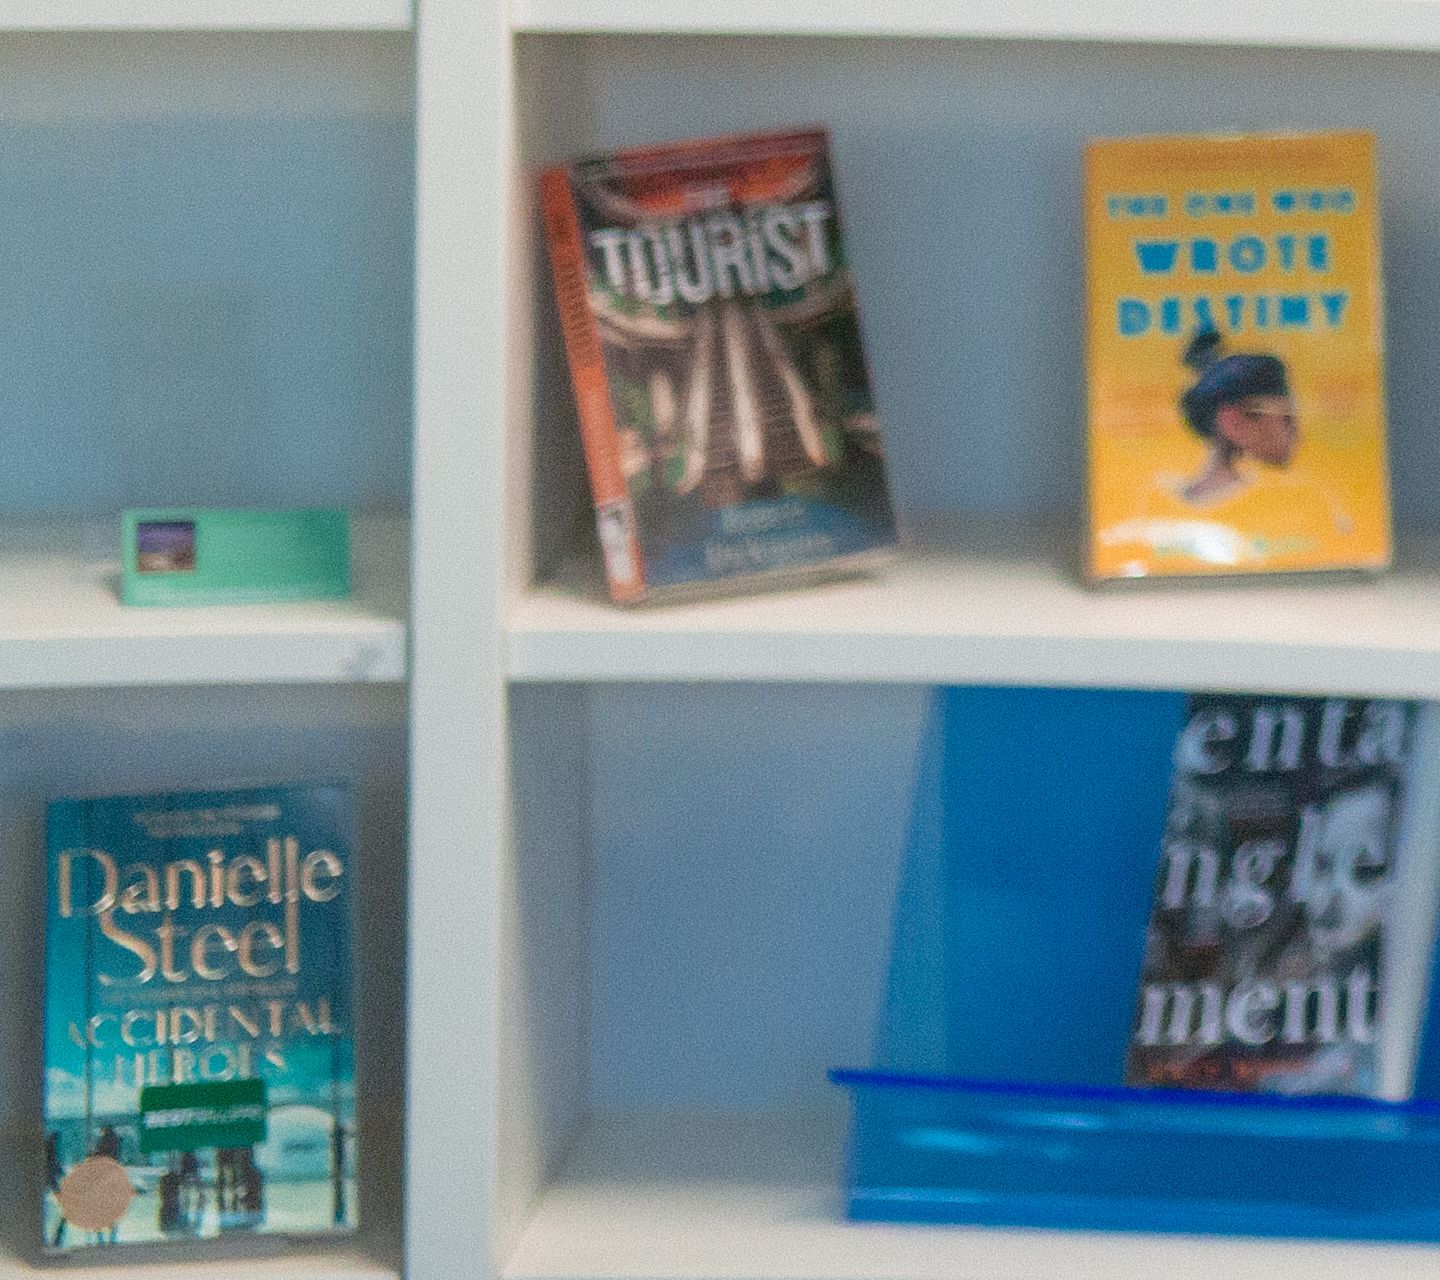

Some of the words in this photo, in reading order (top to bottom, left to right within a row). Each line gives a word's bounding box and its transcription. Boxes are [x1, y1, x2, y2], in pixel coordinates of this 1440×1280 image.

[591, 197, 836, 307] TOURIST
[1133, 232, 1332, 278] WROTE
[57, 835, 344, 920] Danielle
[98, 892, 300, 986] Steel
[67, 996, 342, 1049] ACCIDENTAL
[1137, 966, 1381, 1046] ment
